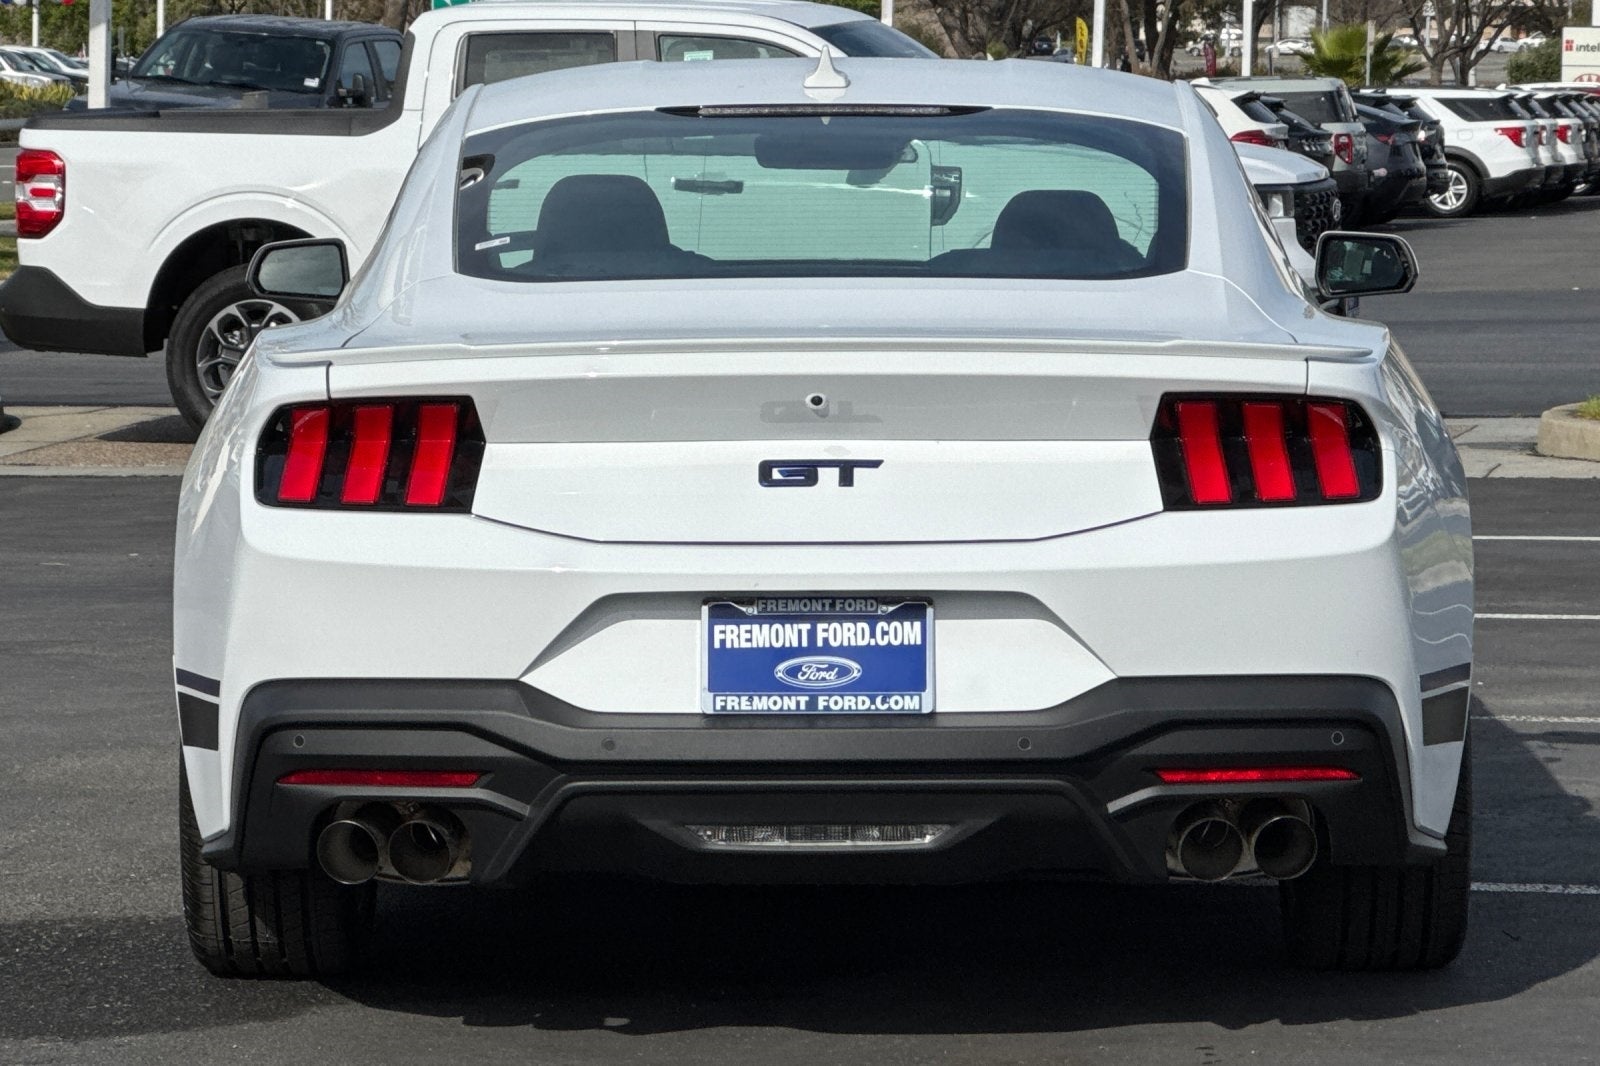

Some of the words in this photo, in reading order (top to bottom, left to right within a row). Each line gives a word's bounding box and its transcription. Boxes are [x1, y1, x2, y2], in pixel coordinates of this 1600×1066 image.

[758, 459, 884, 487] GT
[758, 598, 832, 612] FREMONT
[835, 598, 878, 612] FORD
[713, 623, 811, 649] FREMONT
[817, 621, 922, 647] FORD.COM
[797, 663, 839, 681] Ford
[715, 695, 809, 711] FREMONT
[818, 695, 920, 711] FORD.COM
